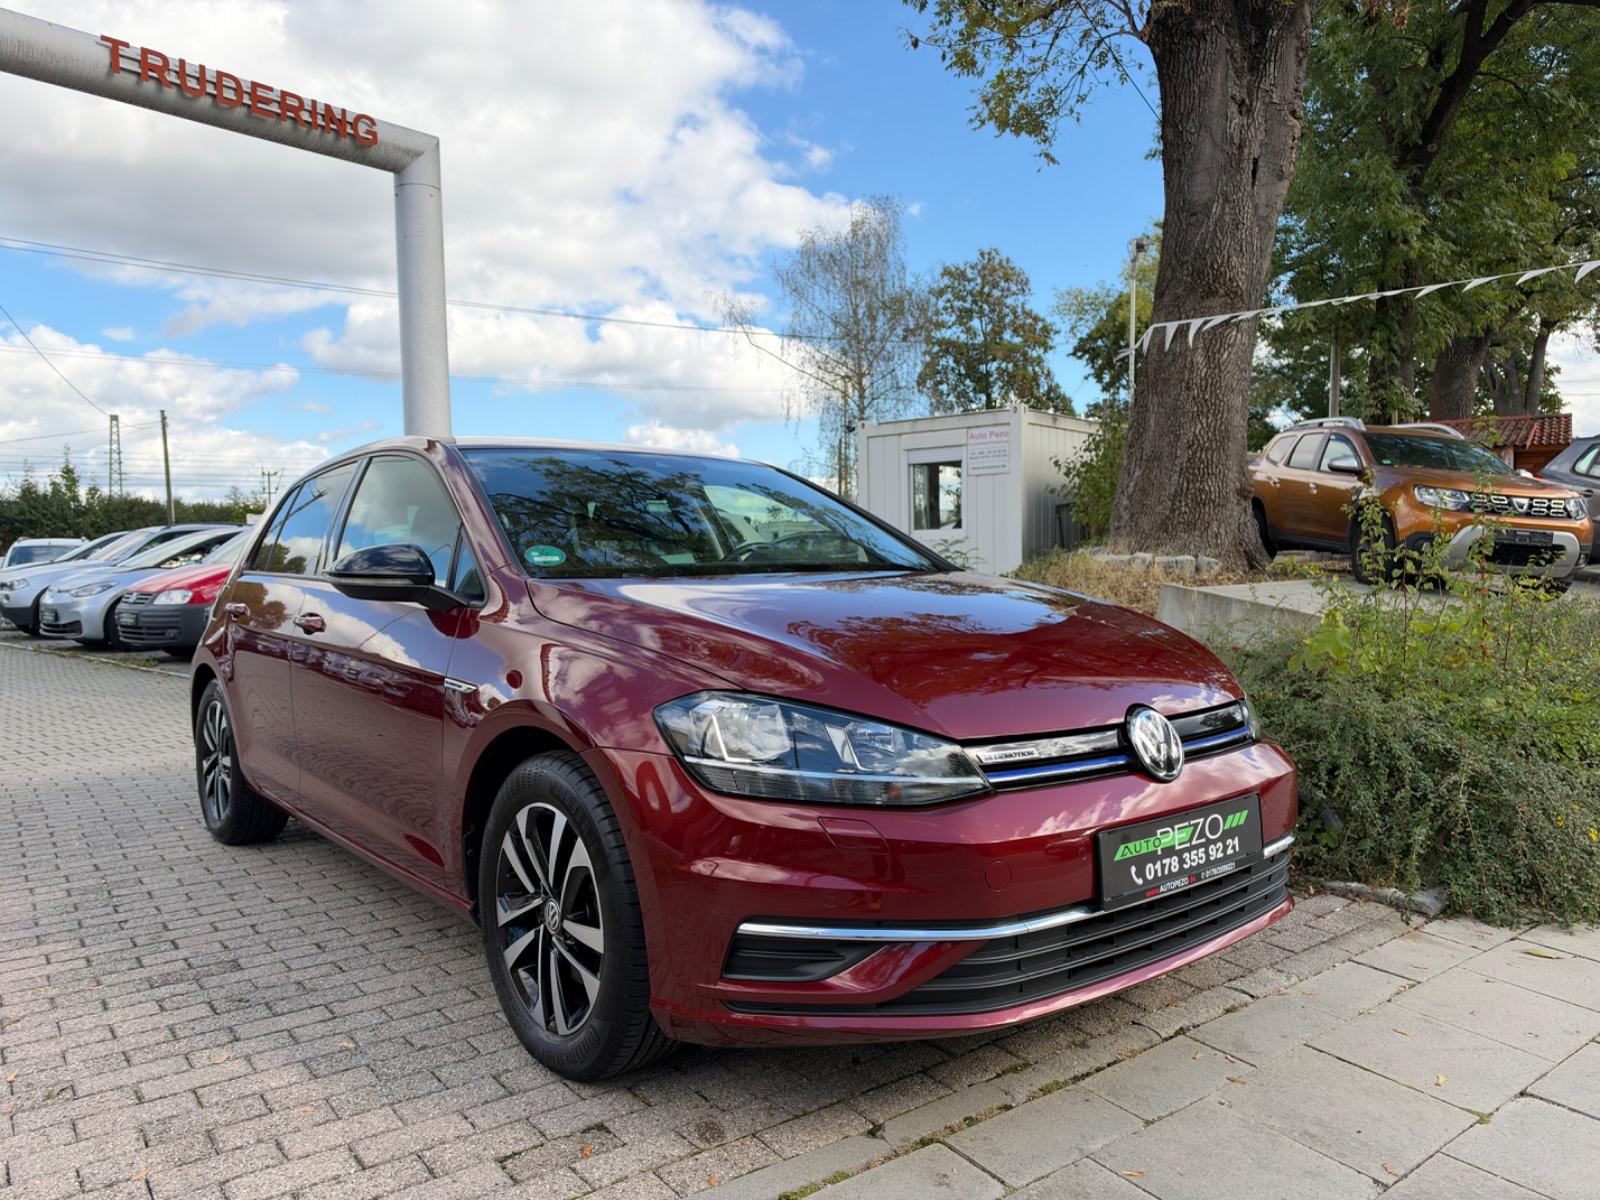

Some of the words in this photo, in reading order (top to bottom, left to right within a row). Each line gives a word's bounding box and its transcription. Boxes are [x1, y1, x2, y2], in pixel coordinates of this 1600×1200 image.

[100, 34, 379, 146] TRUDERING
[1145, 857, 1180, 881] 0178
[1182, 849, 1206, 870] 355
[1208, 844, 1224, 862] 92
[1226, 836, 1240, 853] 21
